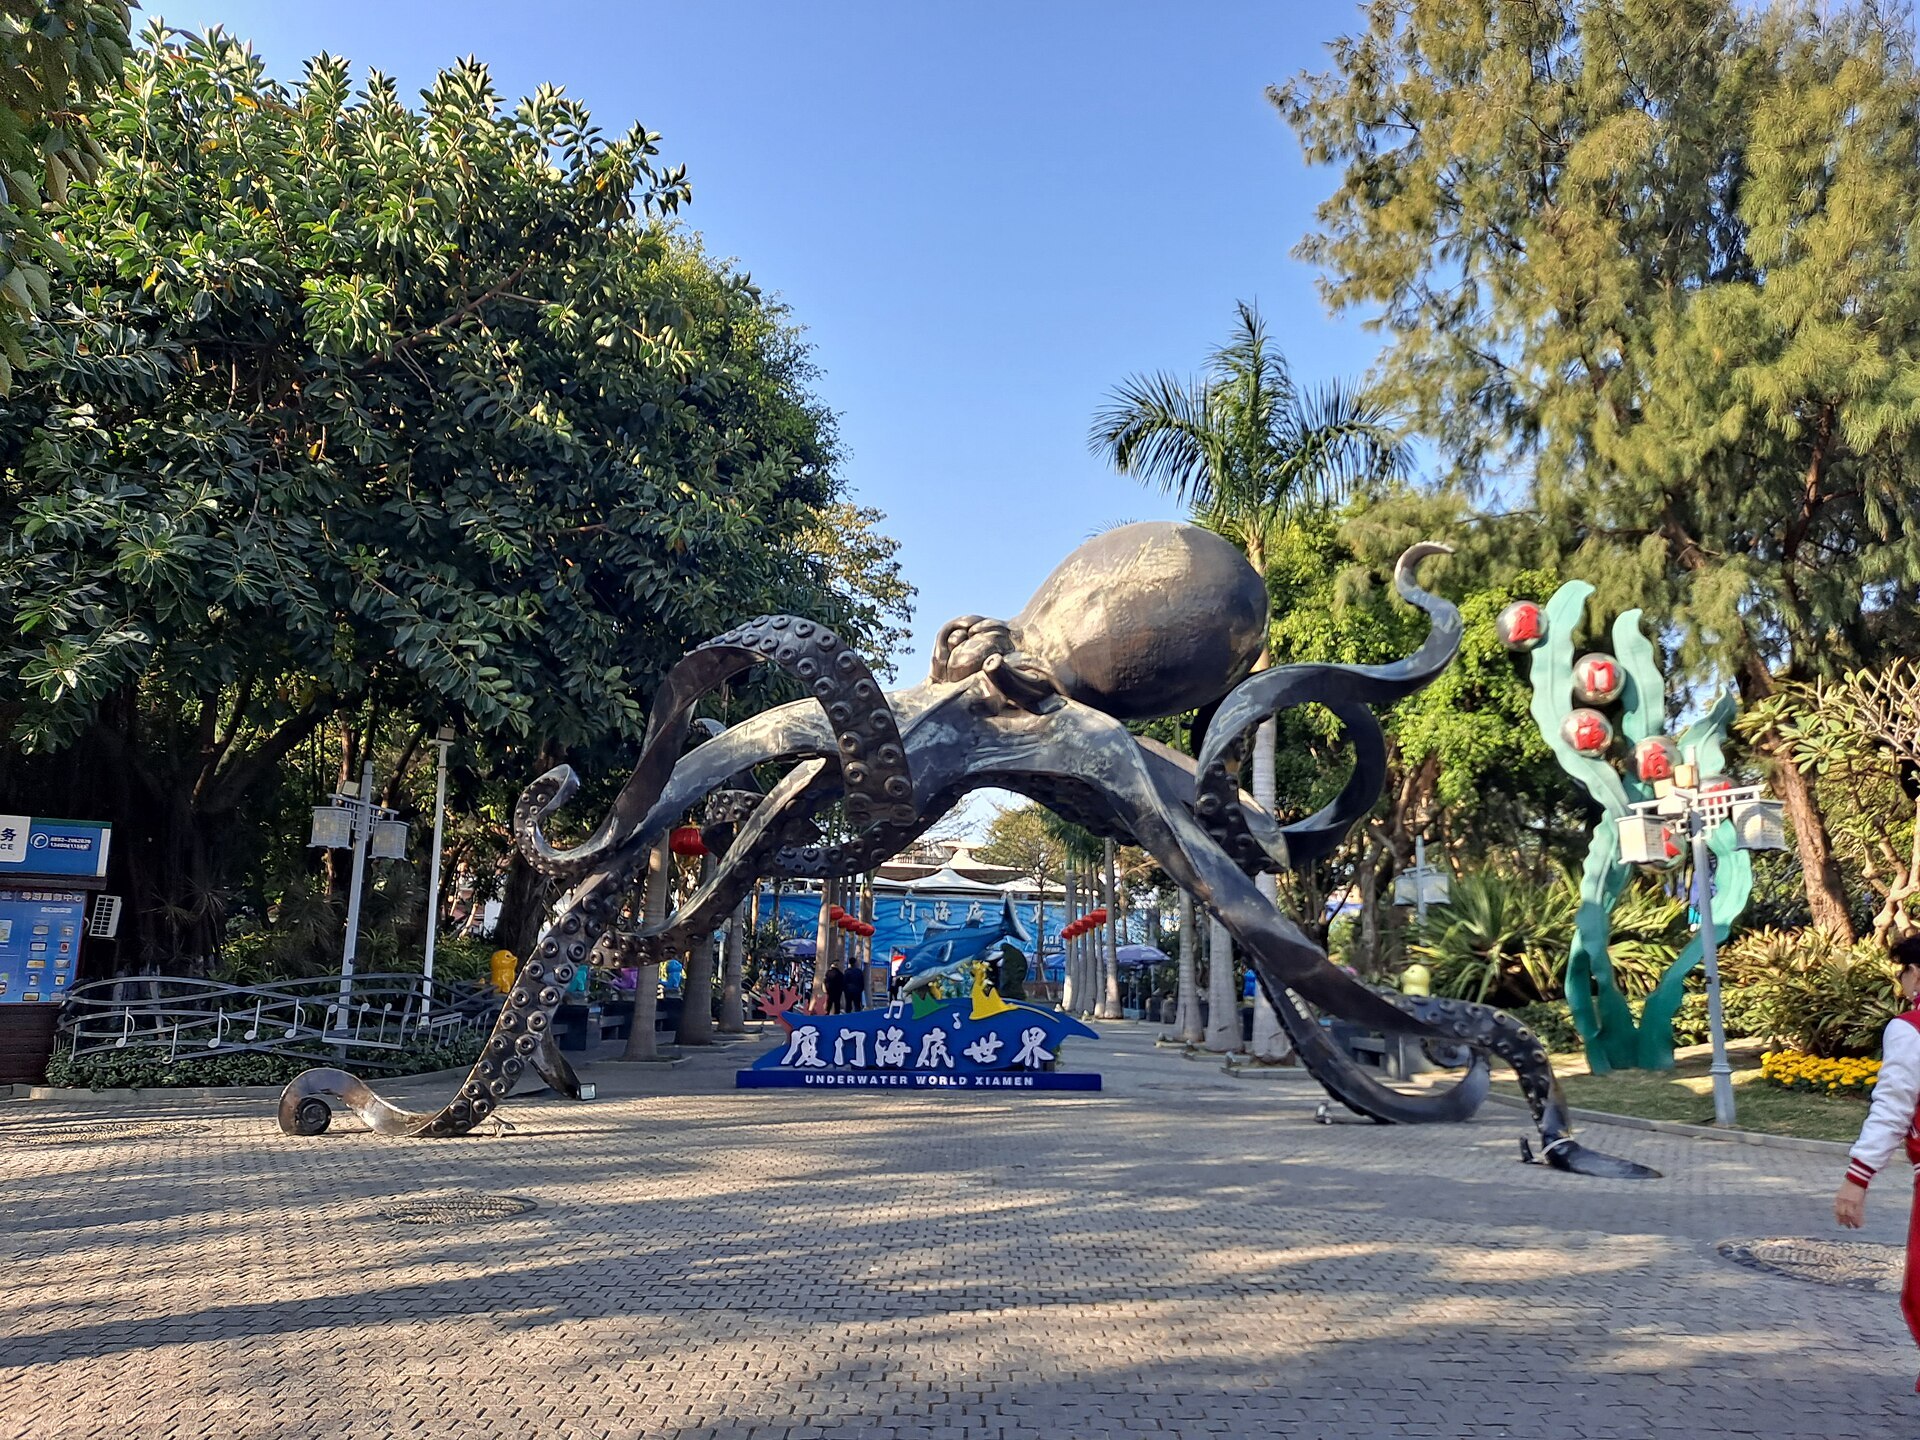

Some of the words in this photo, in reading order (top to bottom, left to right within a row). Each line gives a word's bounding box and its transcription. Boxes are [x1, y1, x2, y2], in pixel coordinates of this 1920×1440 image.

[1586, 660, 1615, 693] 门
[780, 1025, 1055, 1069] 厦门海底世界
[804, 1074, 909, 1085] UNDERWATER
[915, 1075, 968, 1086] WORLD
[975, 1076, 1034, 1087] XIAMEN
